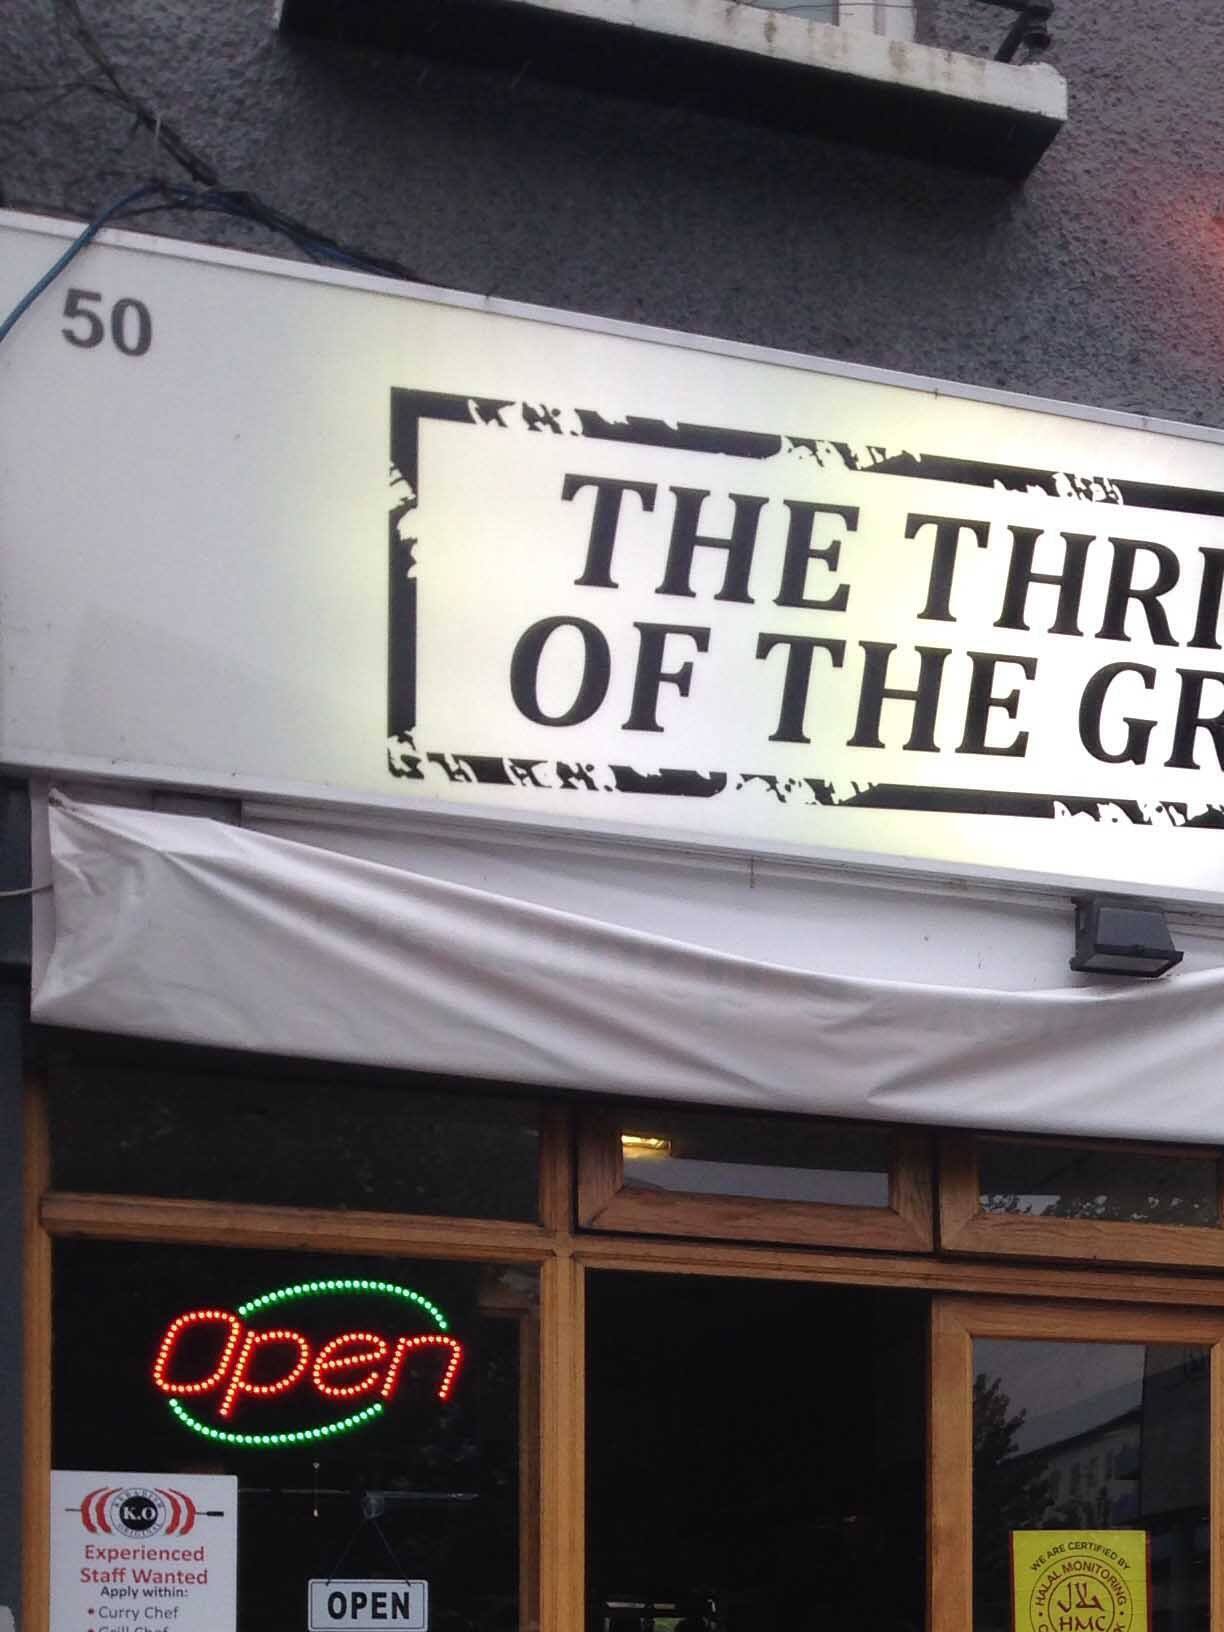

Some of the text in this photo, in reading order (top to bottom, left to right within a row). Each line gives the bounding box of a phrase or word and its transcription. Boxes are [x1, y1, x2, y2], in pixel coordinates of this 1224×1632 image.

[60, 287, 153, 358] 50
[561, 473, 860, 612] THE
[509, 615, 711, 733] OF
[756, 631, 1038, 757] THE
[153, 1310, 463, 1420] Open
[123, 1506, 157, 1521] K.O
[85, 1545, 205, 1563] Experienced
[1030, 1555, 1049, 1573] WE
[1047, 1545, 1066, 1562] ARE
[1067, 1541, 1118, 1561] CERTIFIED
[80, 1568, 208, 1585] Staff Wanted
[1036, 1559, 1127, 1607] HALAL MONITORING
[100, 1586, 188, 1599] Apply within:
[326, 1590, 412, 1621] OPEN
[98, 1606, 179, 1621] Curry Chef
[1059, 1616, 1106, 1632] HMC
